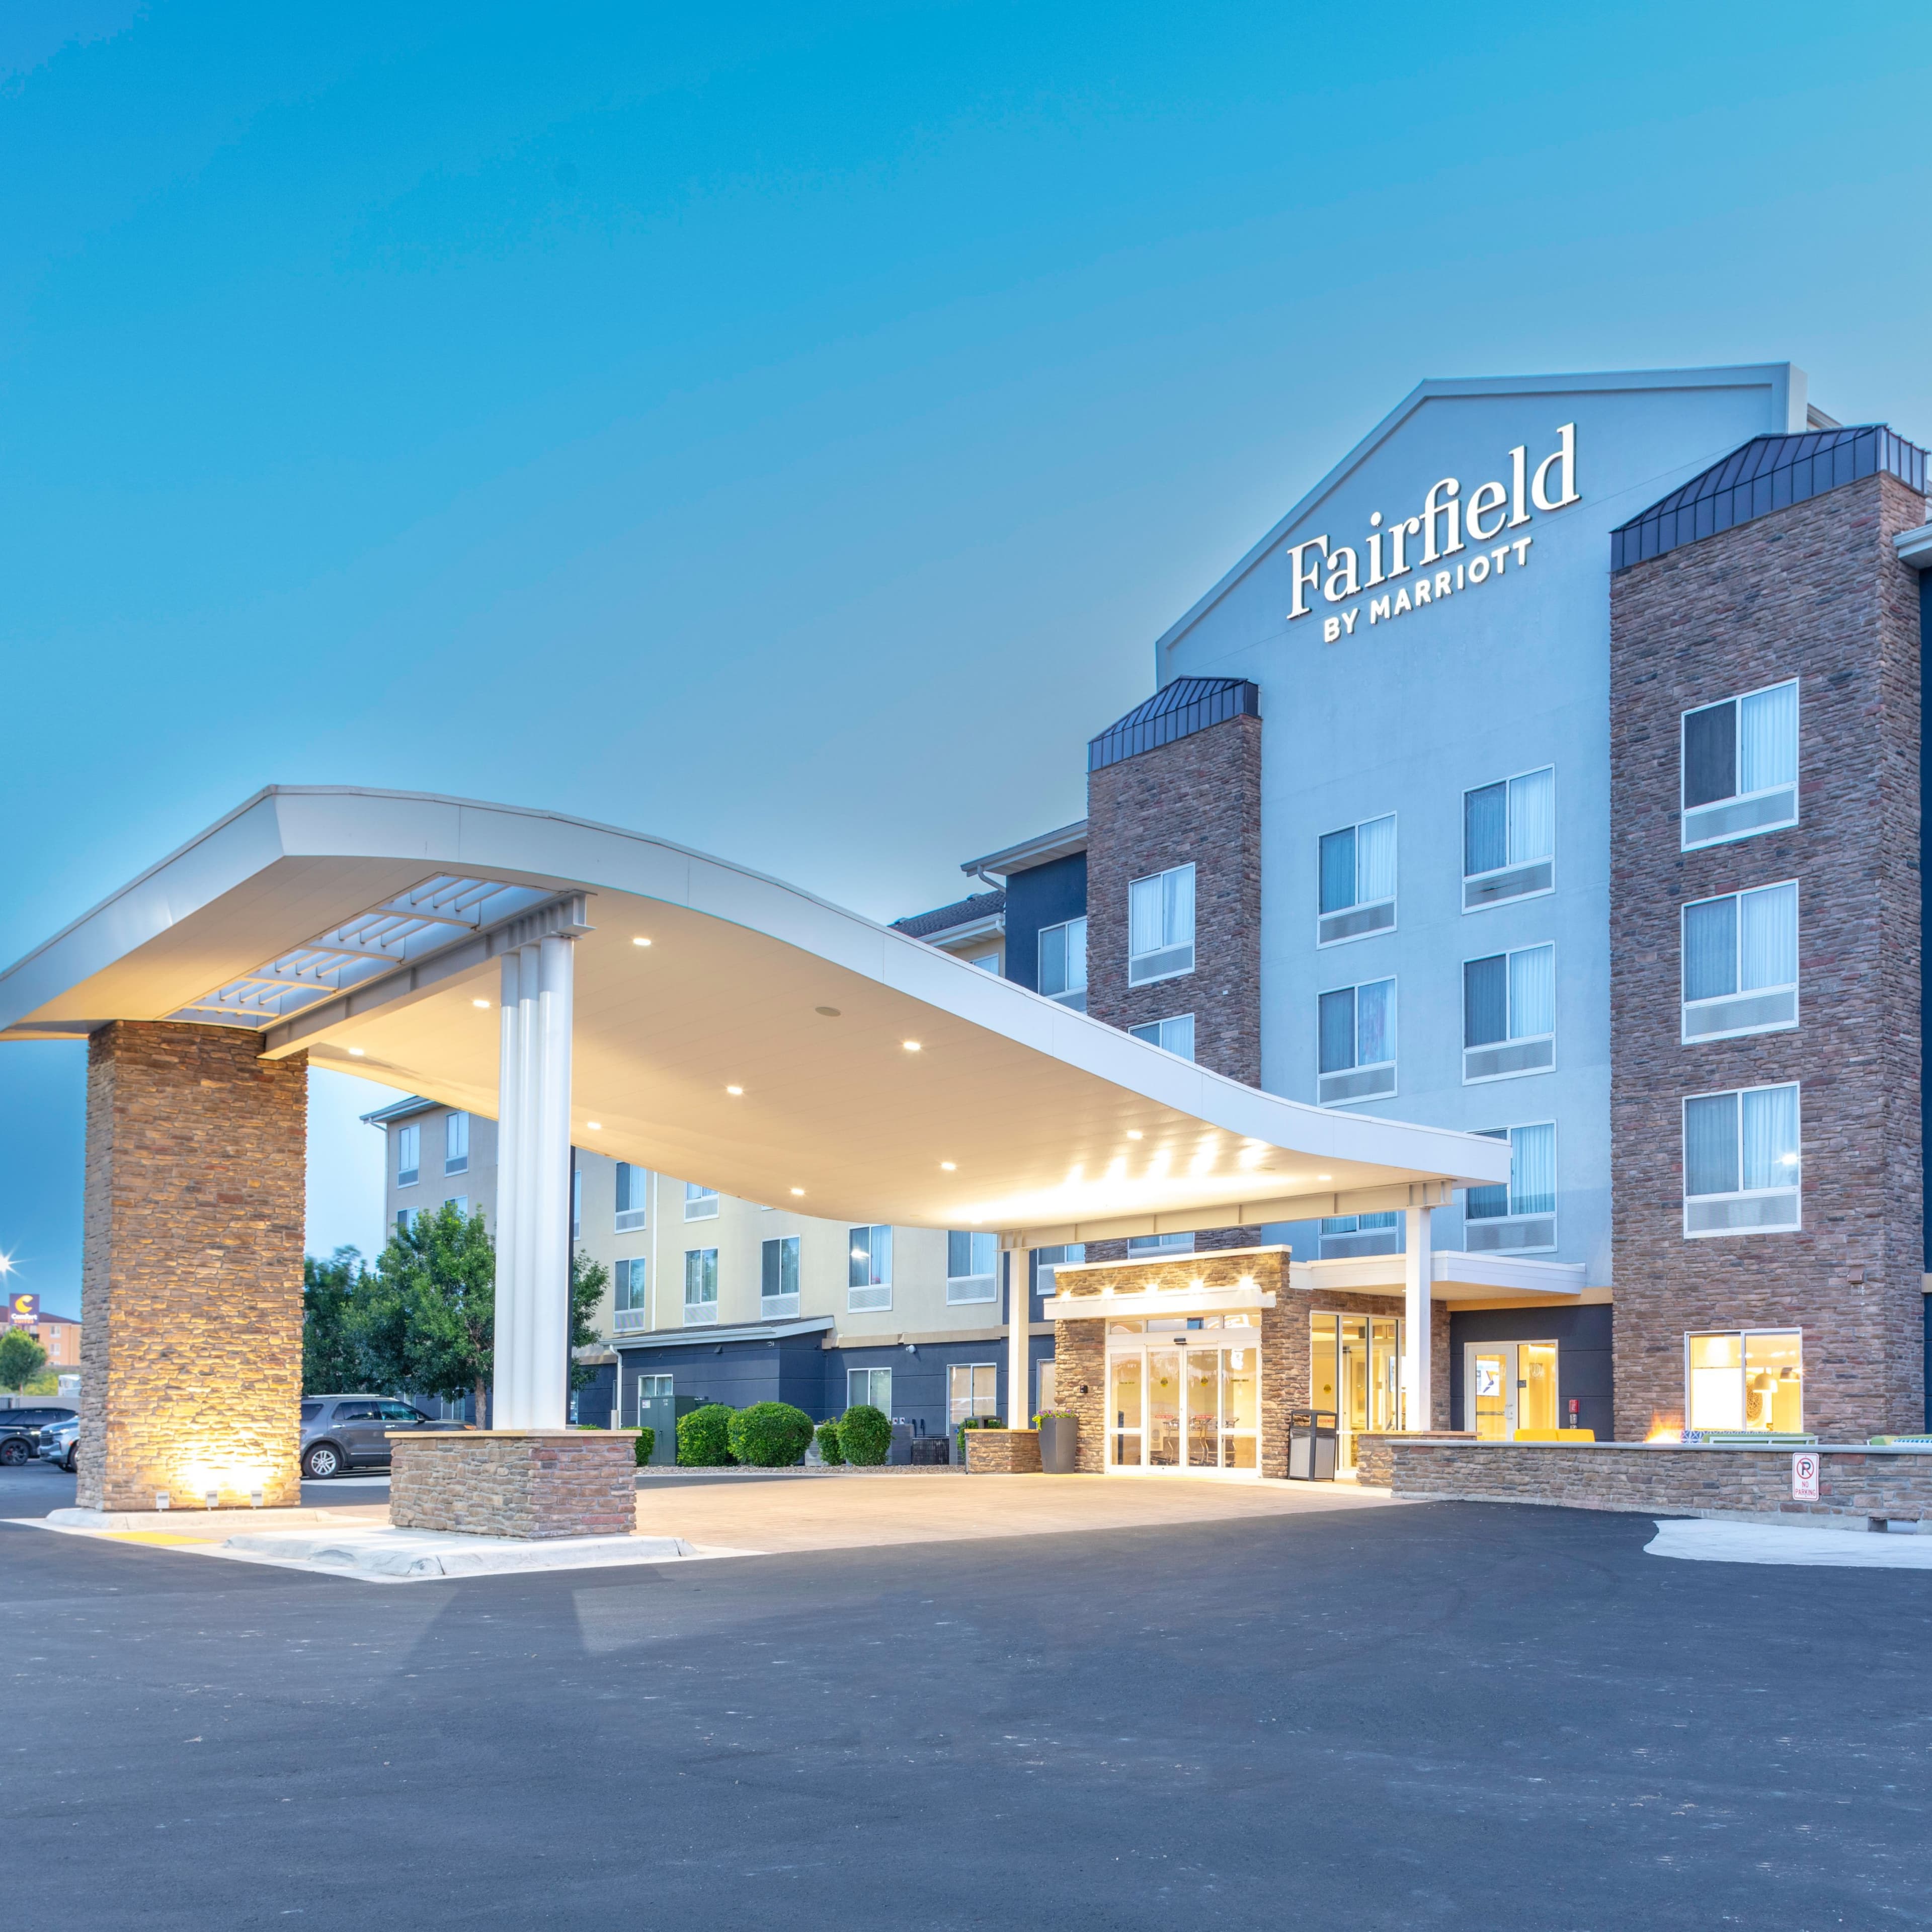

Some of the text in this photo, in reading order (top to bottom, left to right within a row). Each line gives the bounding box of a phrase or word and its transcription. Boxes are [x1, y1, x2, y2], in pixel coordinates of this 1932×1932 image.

[1287, 422, 1581, 620] Fairfield
[1324, 537, 1533, 642] BY MARRIOTT
